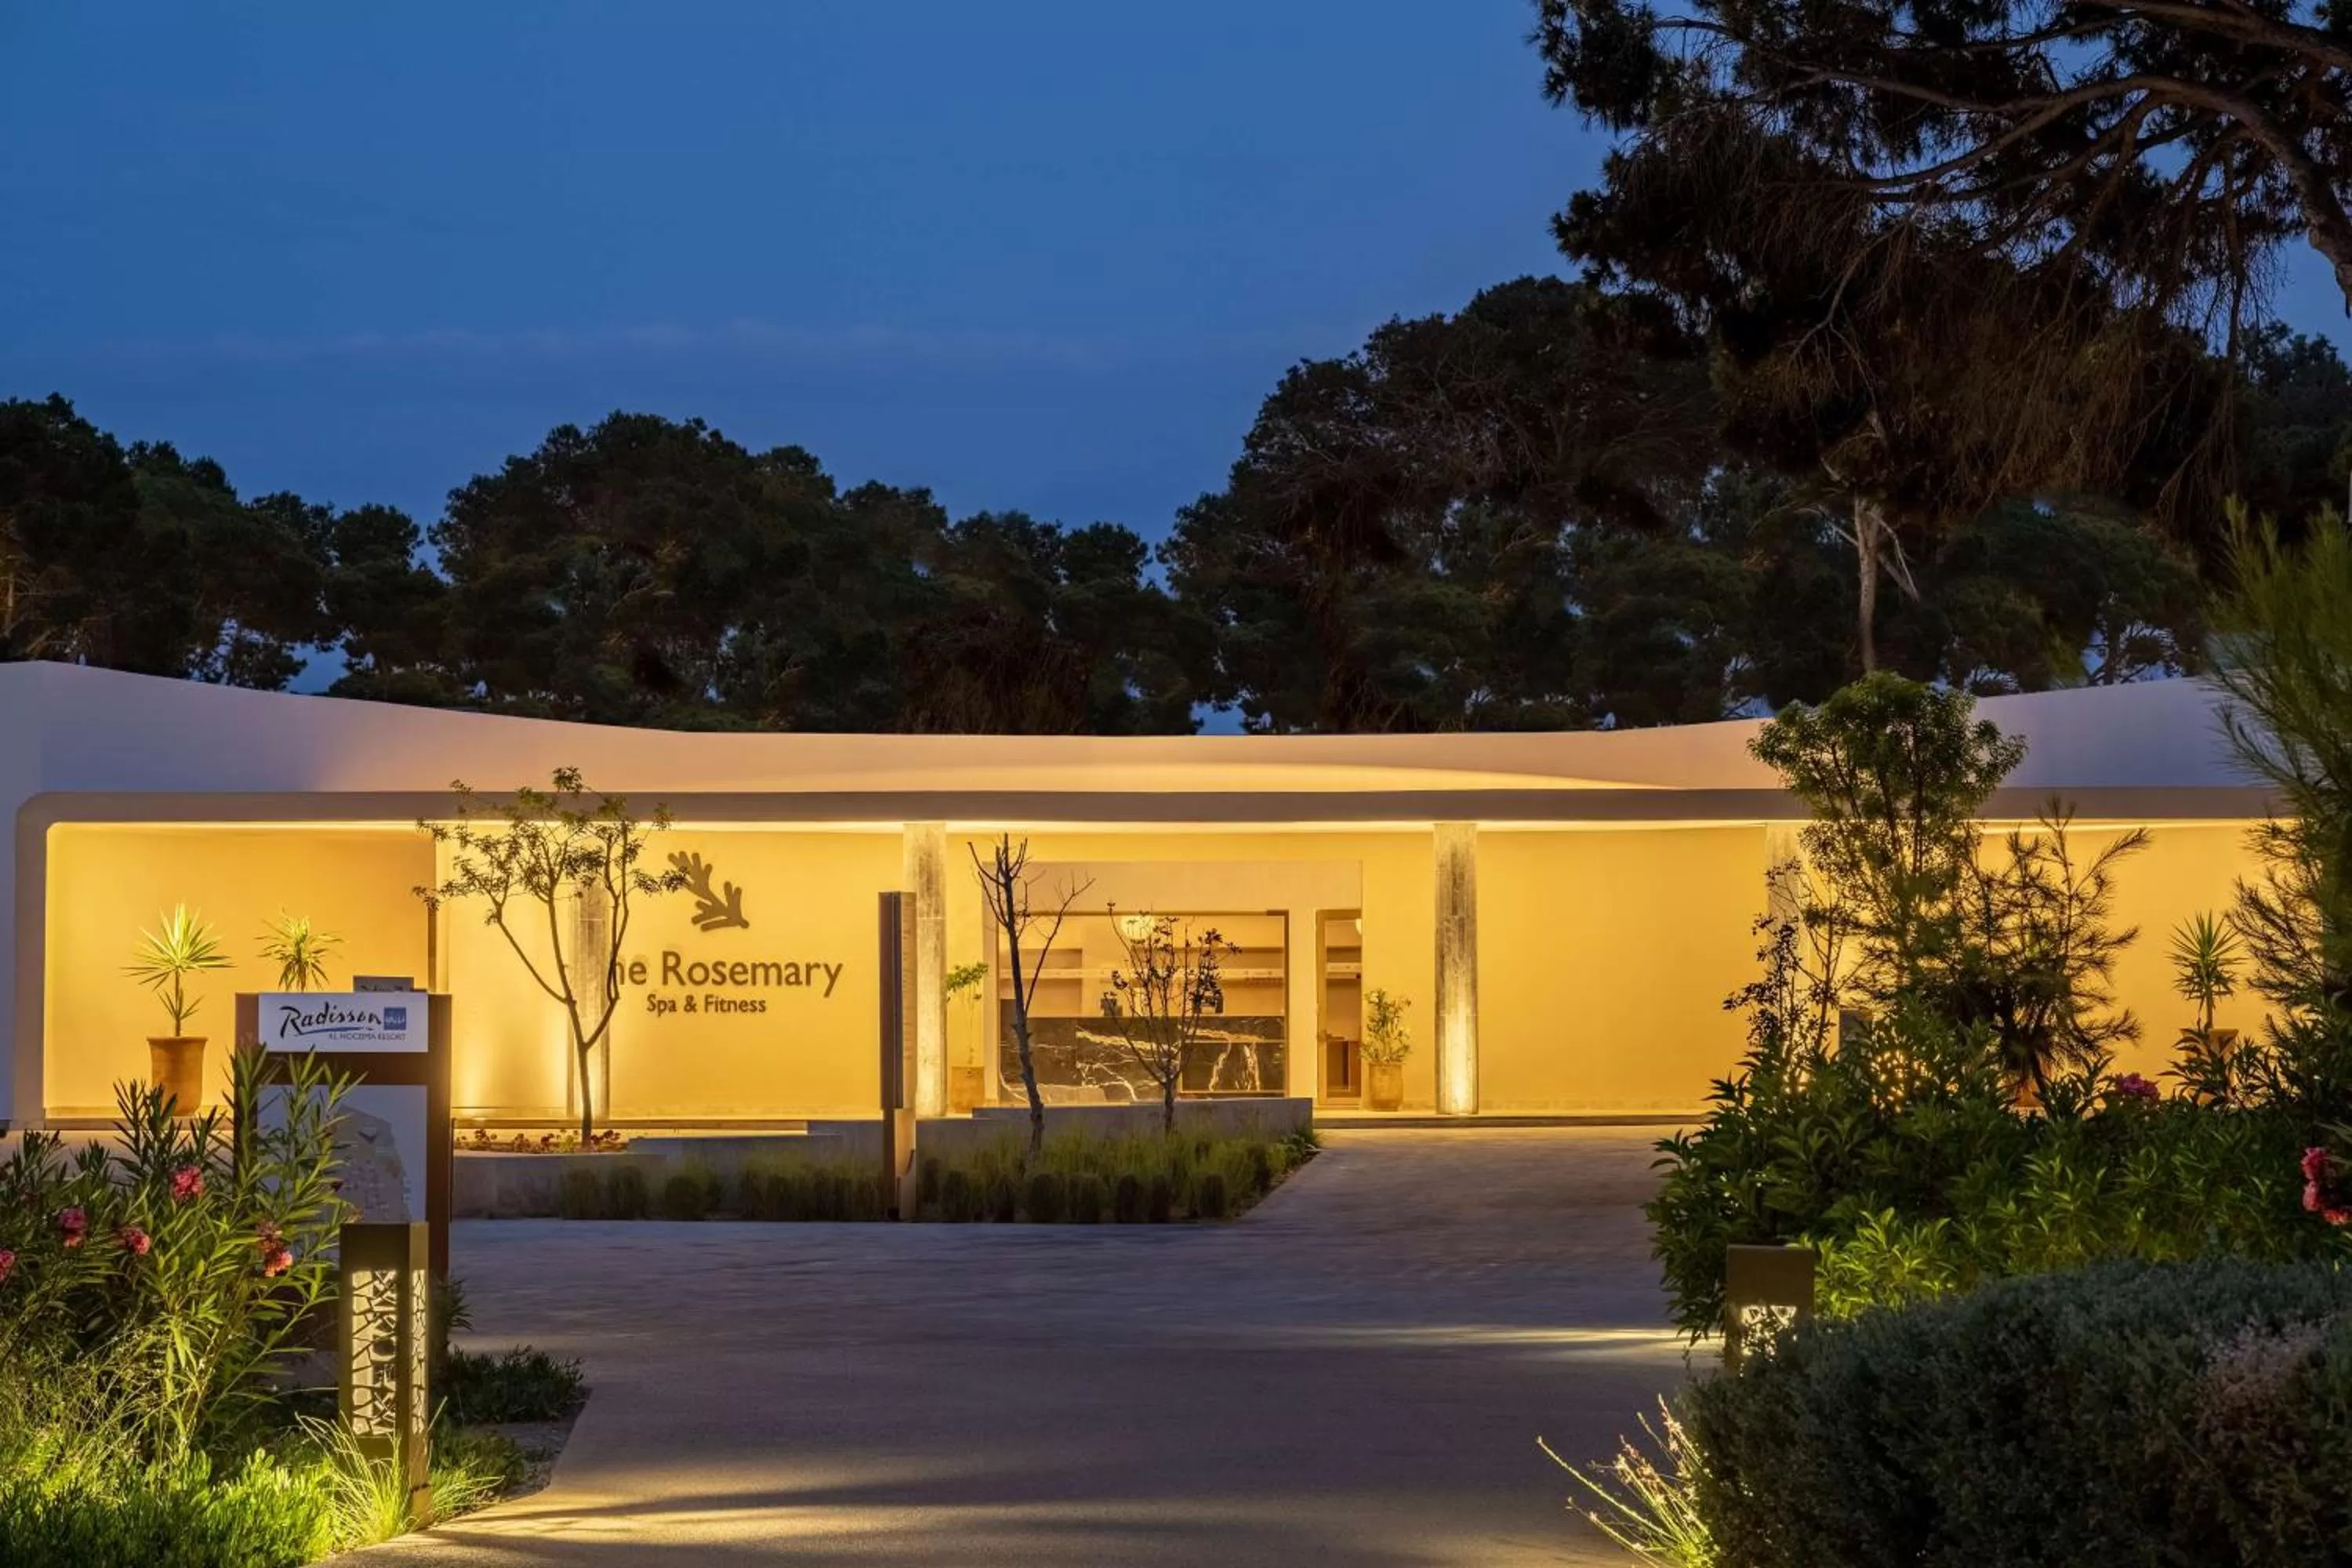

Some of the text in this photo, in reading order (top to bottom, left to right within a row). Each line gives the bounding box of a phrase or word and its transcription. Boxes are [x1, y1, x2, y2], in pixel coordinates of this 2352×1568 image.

[662, 950, 844, 997] Rosemary
[280, 1000, 382, 1039] Radisson
[646, 994, 766, 1016] Spa & Fitness
